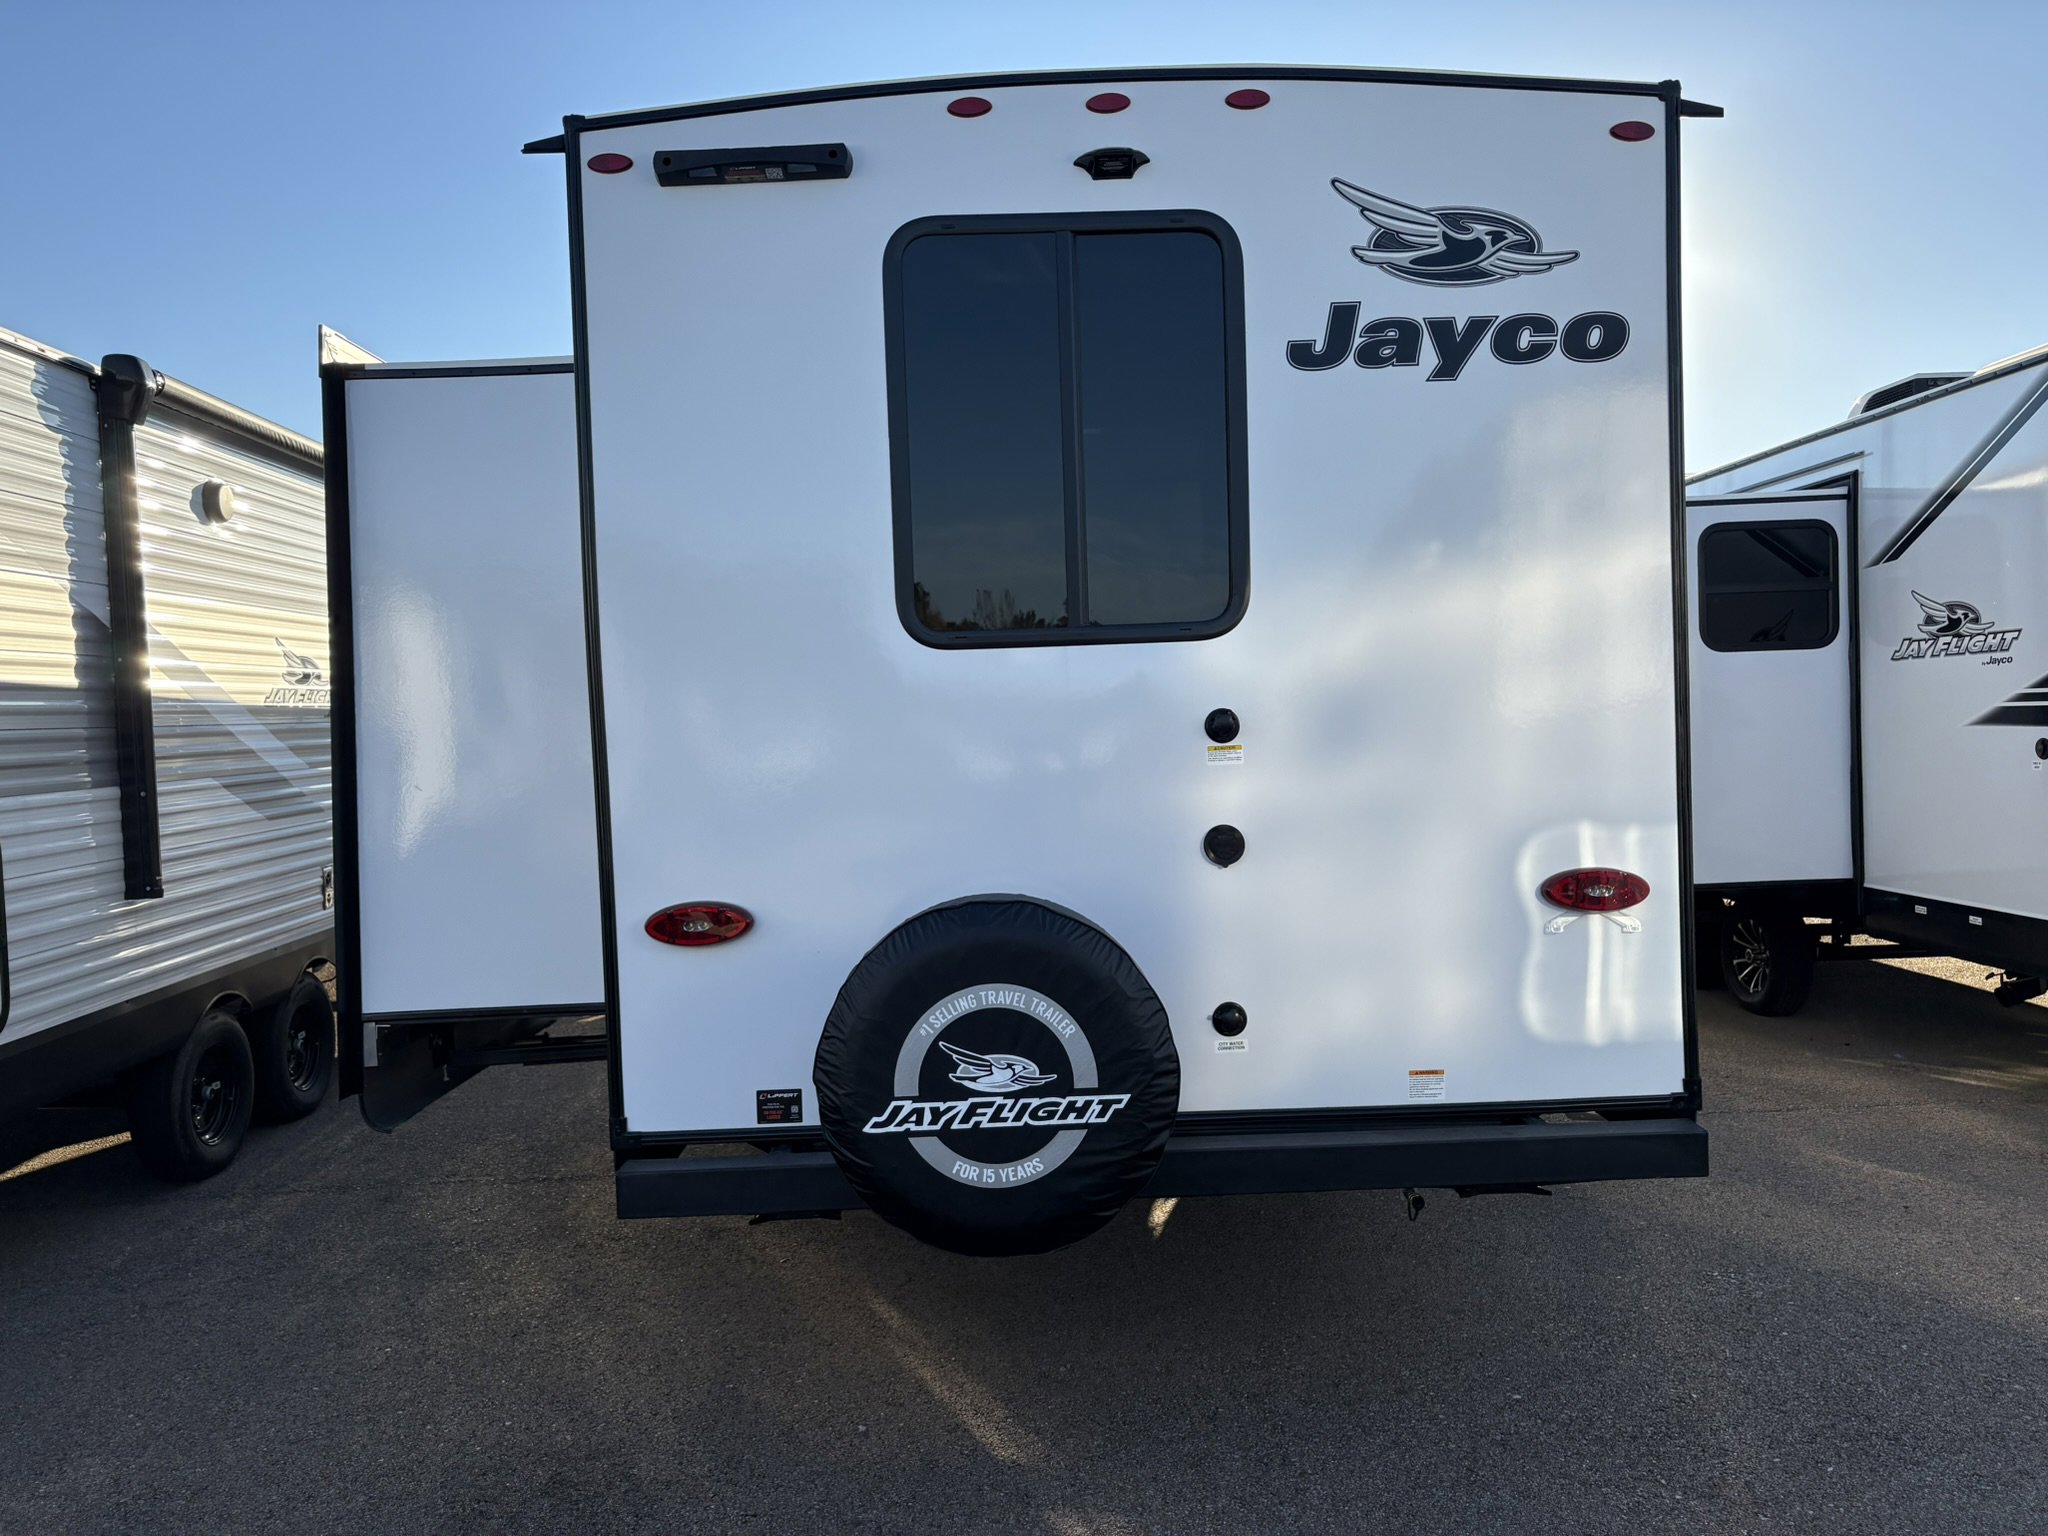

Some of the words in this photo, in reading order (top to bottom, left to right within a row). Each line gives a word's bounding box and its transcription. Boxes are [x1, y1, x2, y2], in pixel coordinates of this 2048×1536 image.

[1286, 301, 1630, 382] Jayco
[1986, 656, 2013, 666] Jayco
[919, 1024, 934, 1037] #1
[929, 994, 977, 1028] SELLING
[979, 990, 1026, 1008] TRAVEL
[1032, 997, 1076, 1039] TRAILER
[952, 1160, 979, 1182] FOR
[982, 1168, 996, 1183] 15
[999, 1157, 1044, 1182] YEARS
